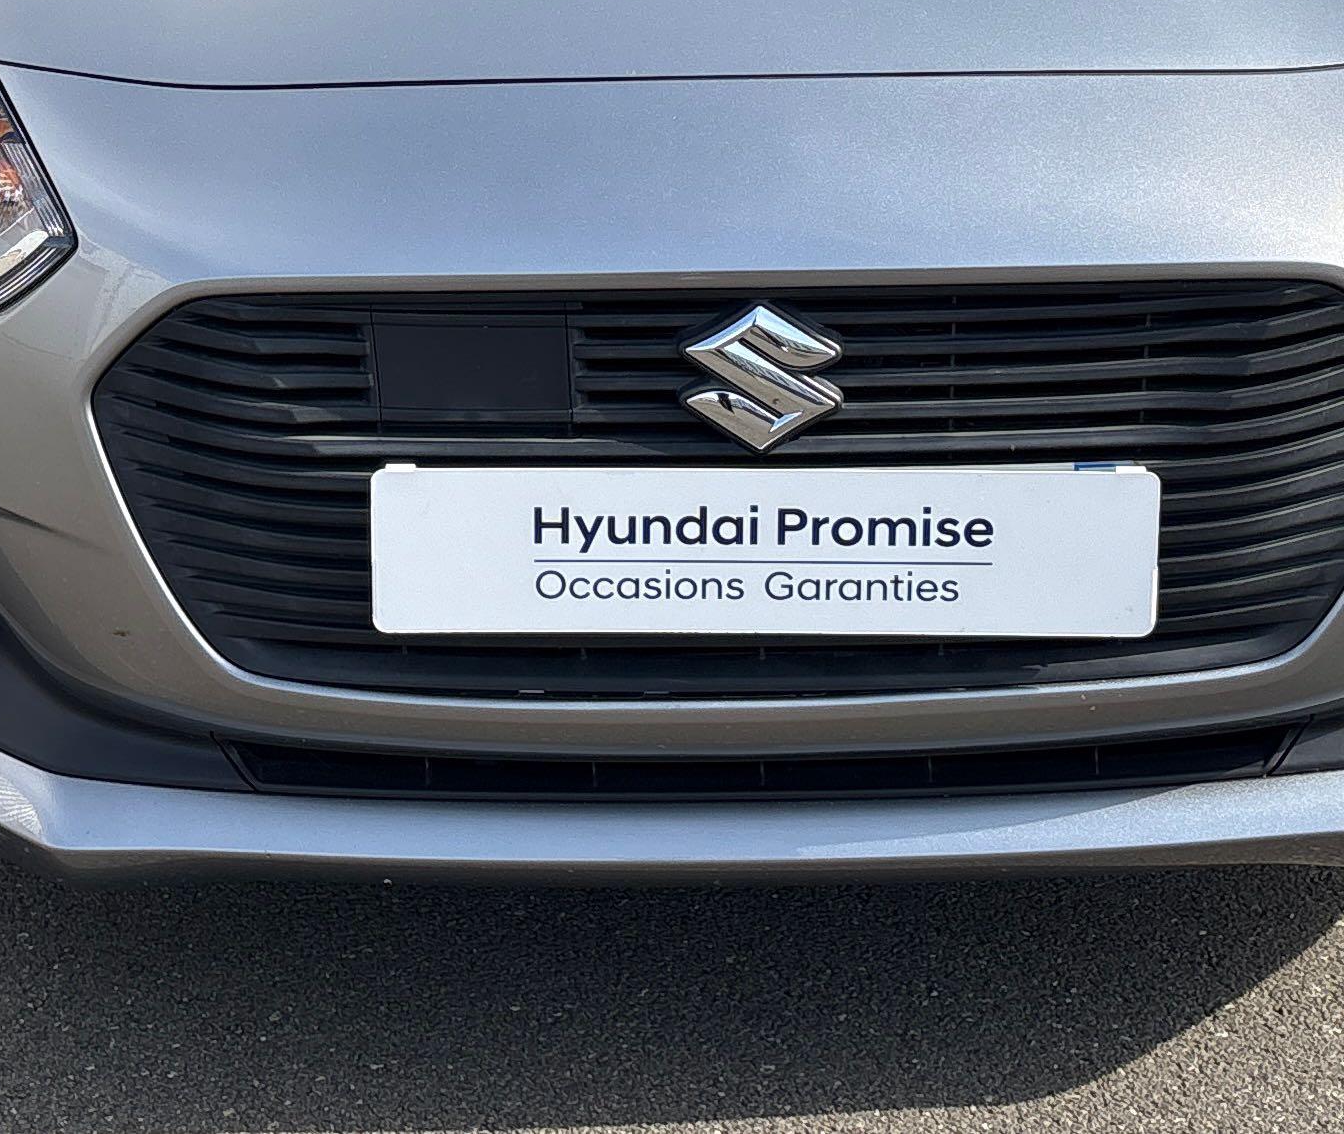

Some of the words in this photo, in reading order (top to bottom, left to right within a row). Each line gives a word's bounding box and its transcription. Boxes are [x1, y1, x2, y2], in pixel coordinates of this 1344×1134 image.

[533, 504, 759, 555] Hyundai
[776, 505, 995, 549] Promise
[534, 569, 746, 602] Occasions
[763, 570, 960, 603] Garanties
